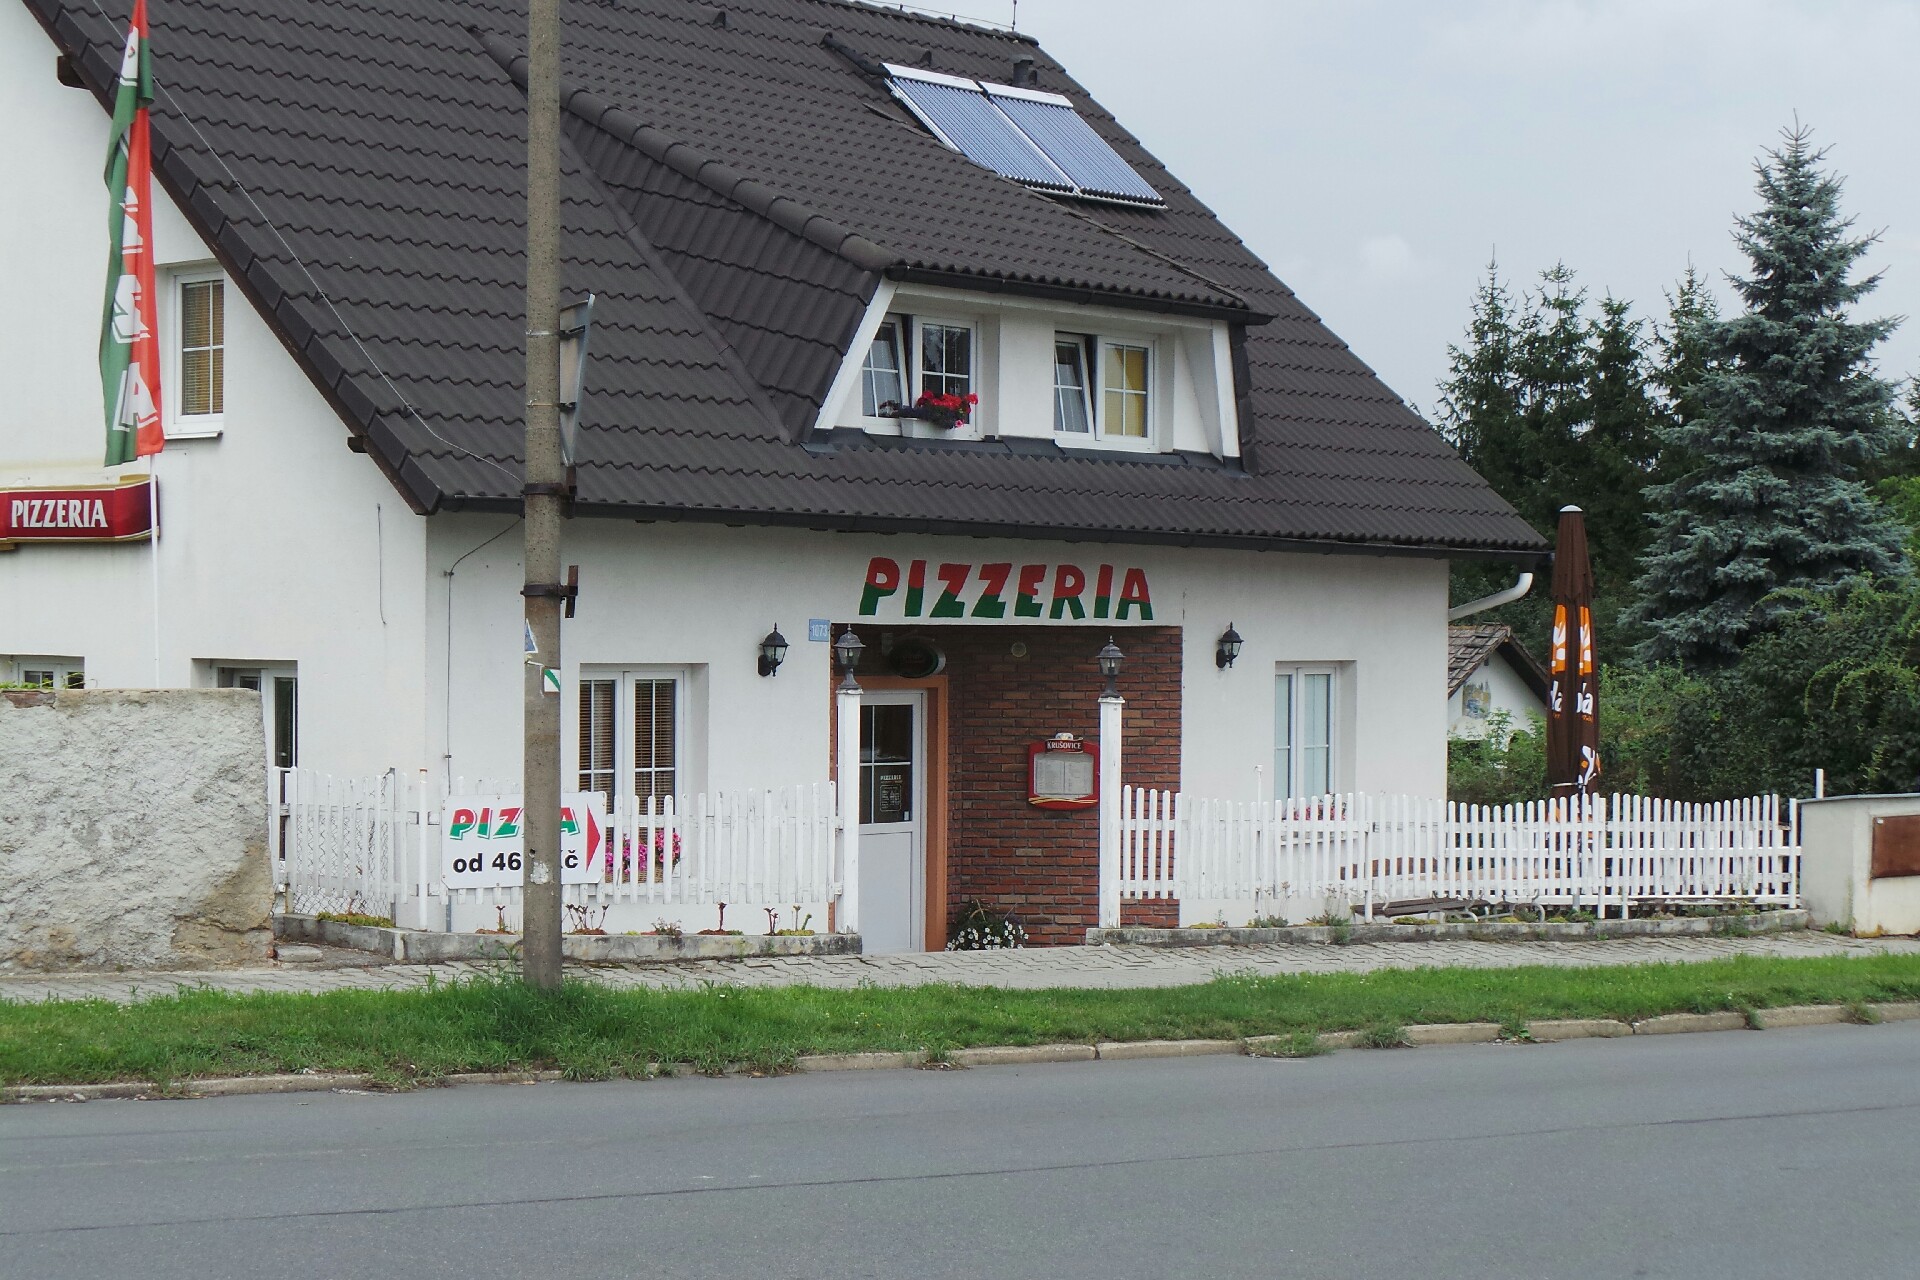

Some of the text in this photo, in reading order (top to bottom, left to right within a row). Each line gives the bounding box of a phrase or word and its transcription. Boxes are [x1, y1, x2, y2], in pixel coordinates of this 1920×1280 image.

[11, 499, 109, 528] PIZZERIA
[858, 556, 1154, 621] PIZZERIA
[811, 624, 828, 637] 1073
[1046, 740, 1082, 749] KRUŠOVICE
[449, 806, 580, 840] PIZA
[453, 852, 483, 873] od
